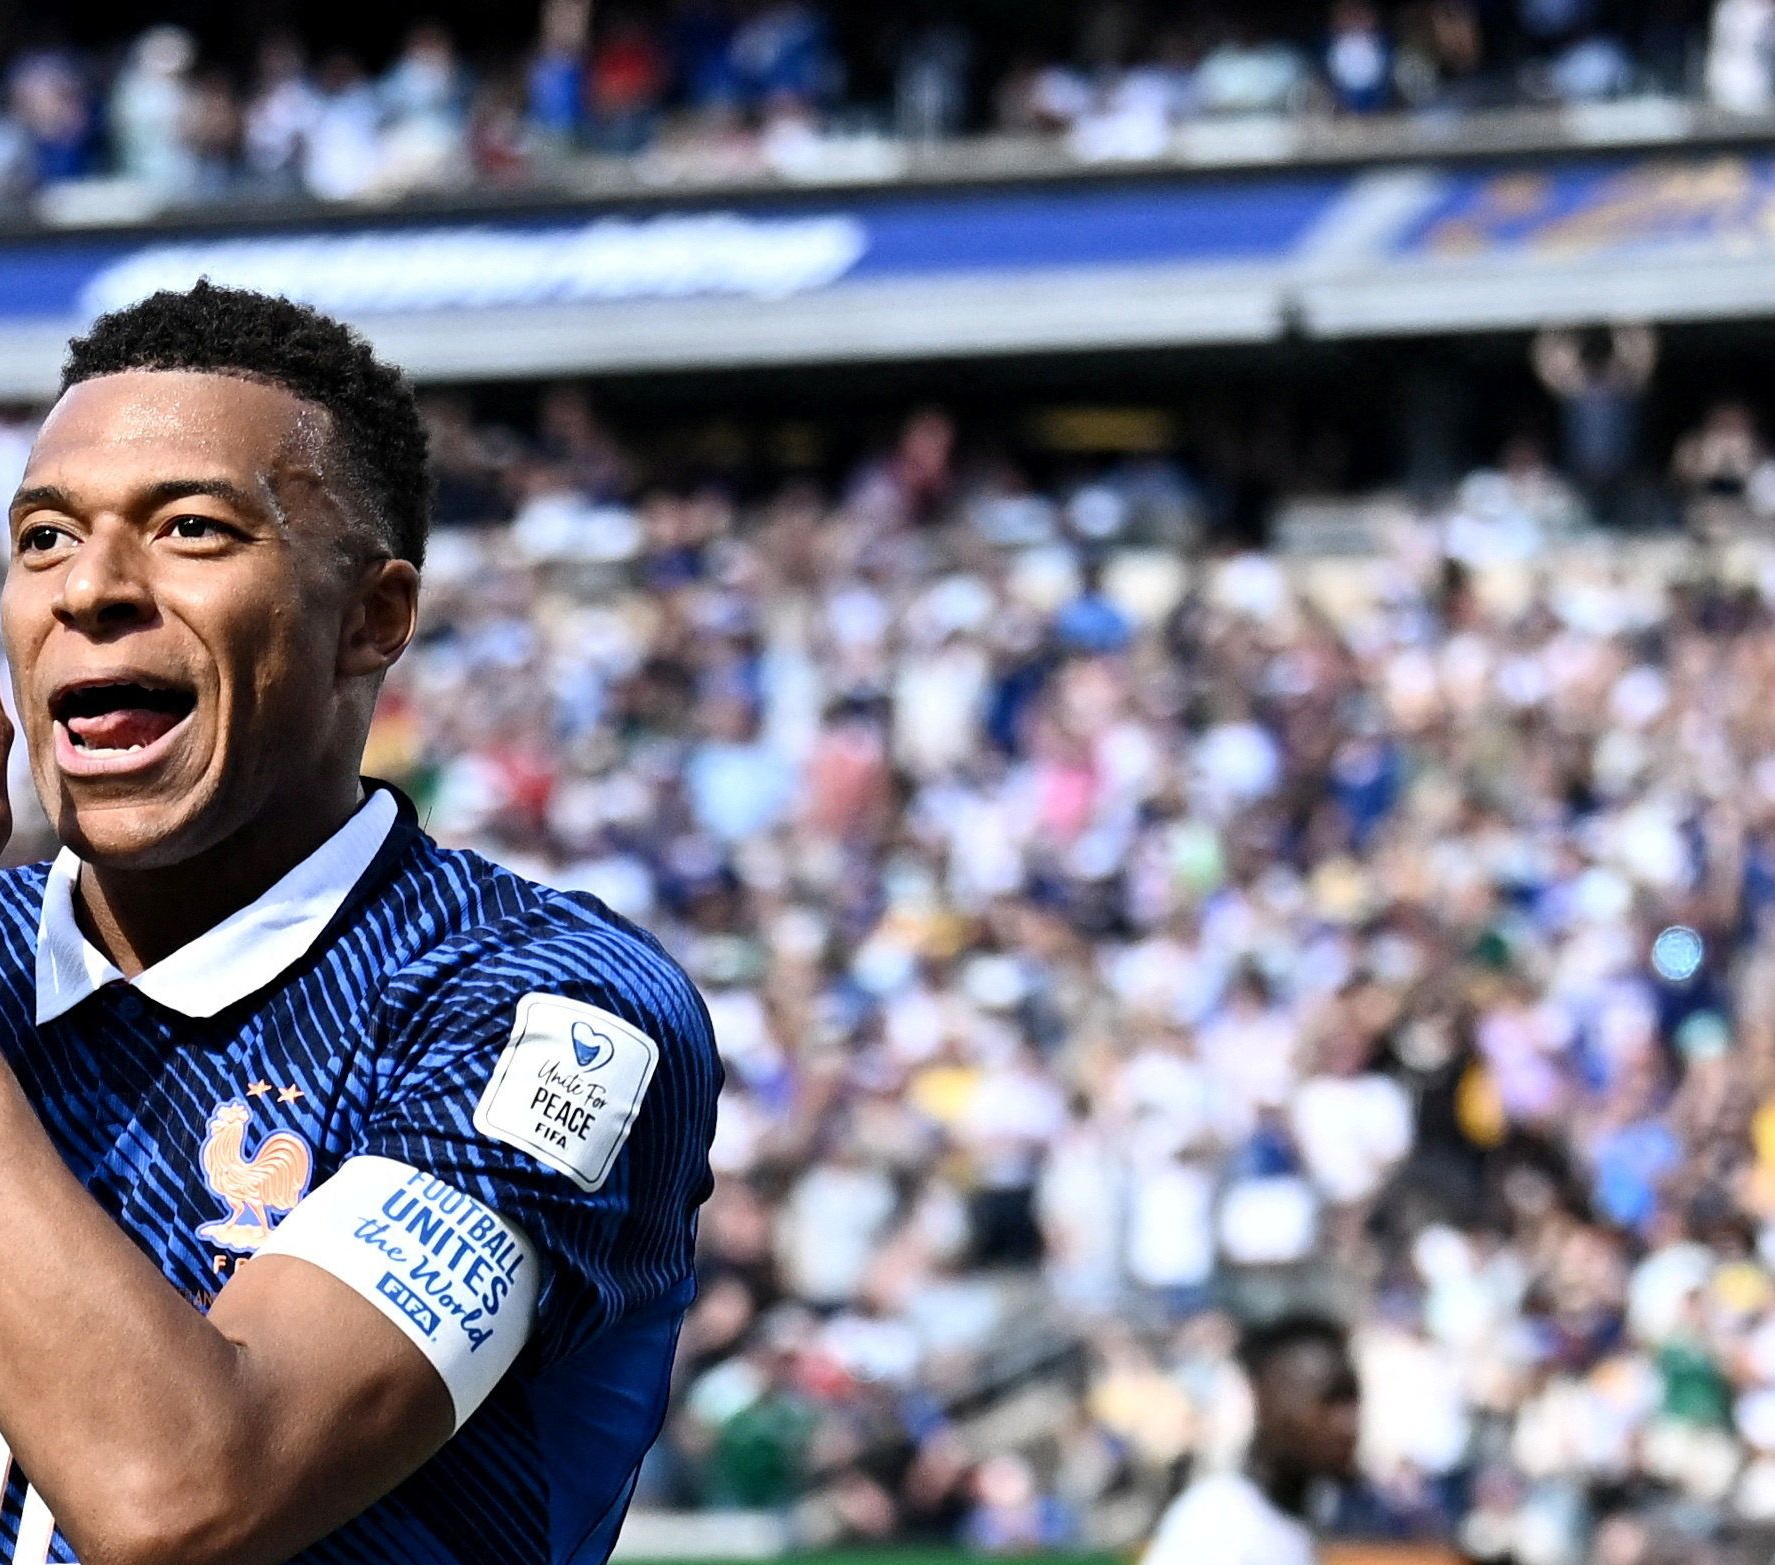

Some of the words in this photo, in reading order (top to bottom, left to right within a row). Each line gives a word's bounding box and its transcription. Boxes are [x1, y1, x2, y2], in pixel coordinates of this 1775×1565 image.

[537, 1059, 584, 1096] Unite
[584, 1083, 607, 1110] For
[530, 1087, 596, 1141] PEACE
[534, 1122, 567, 1150] FIFA
[381, 1188, 508, 1316] UNITES
[406, 1170, 525, 1286] FOOTBALL
[353, 1216, 407, 1263] the
[409, 1254, 494, 1353] World
[379, 1276, 438, 1334] FIFA
